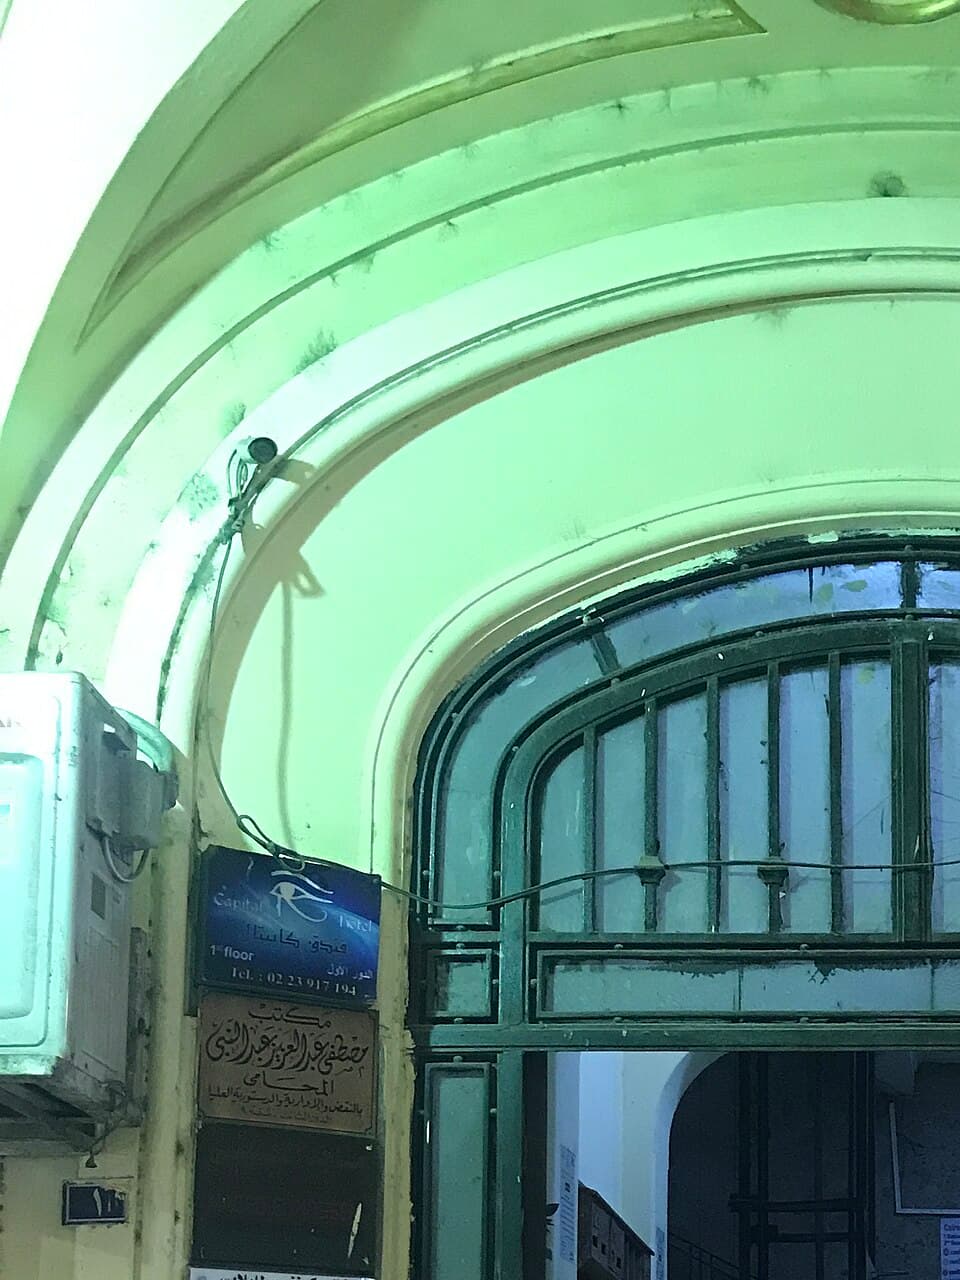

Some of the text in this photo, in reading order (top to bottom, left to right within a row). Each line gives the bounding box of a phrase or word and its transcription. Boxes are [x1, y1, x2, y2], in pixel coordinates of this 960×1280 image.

[224, 945, 255, 961] floor
[267, 971, 283, 985] 02
[248, 1003, 332, 1029] مكتب
